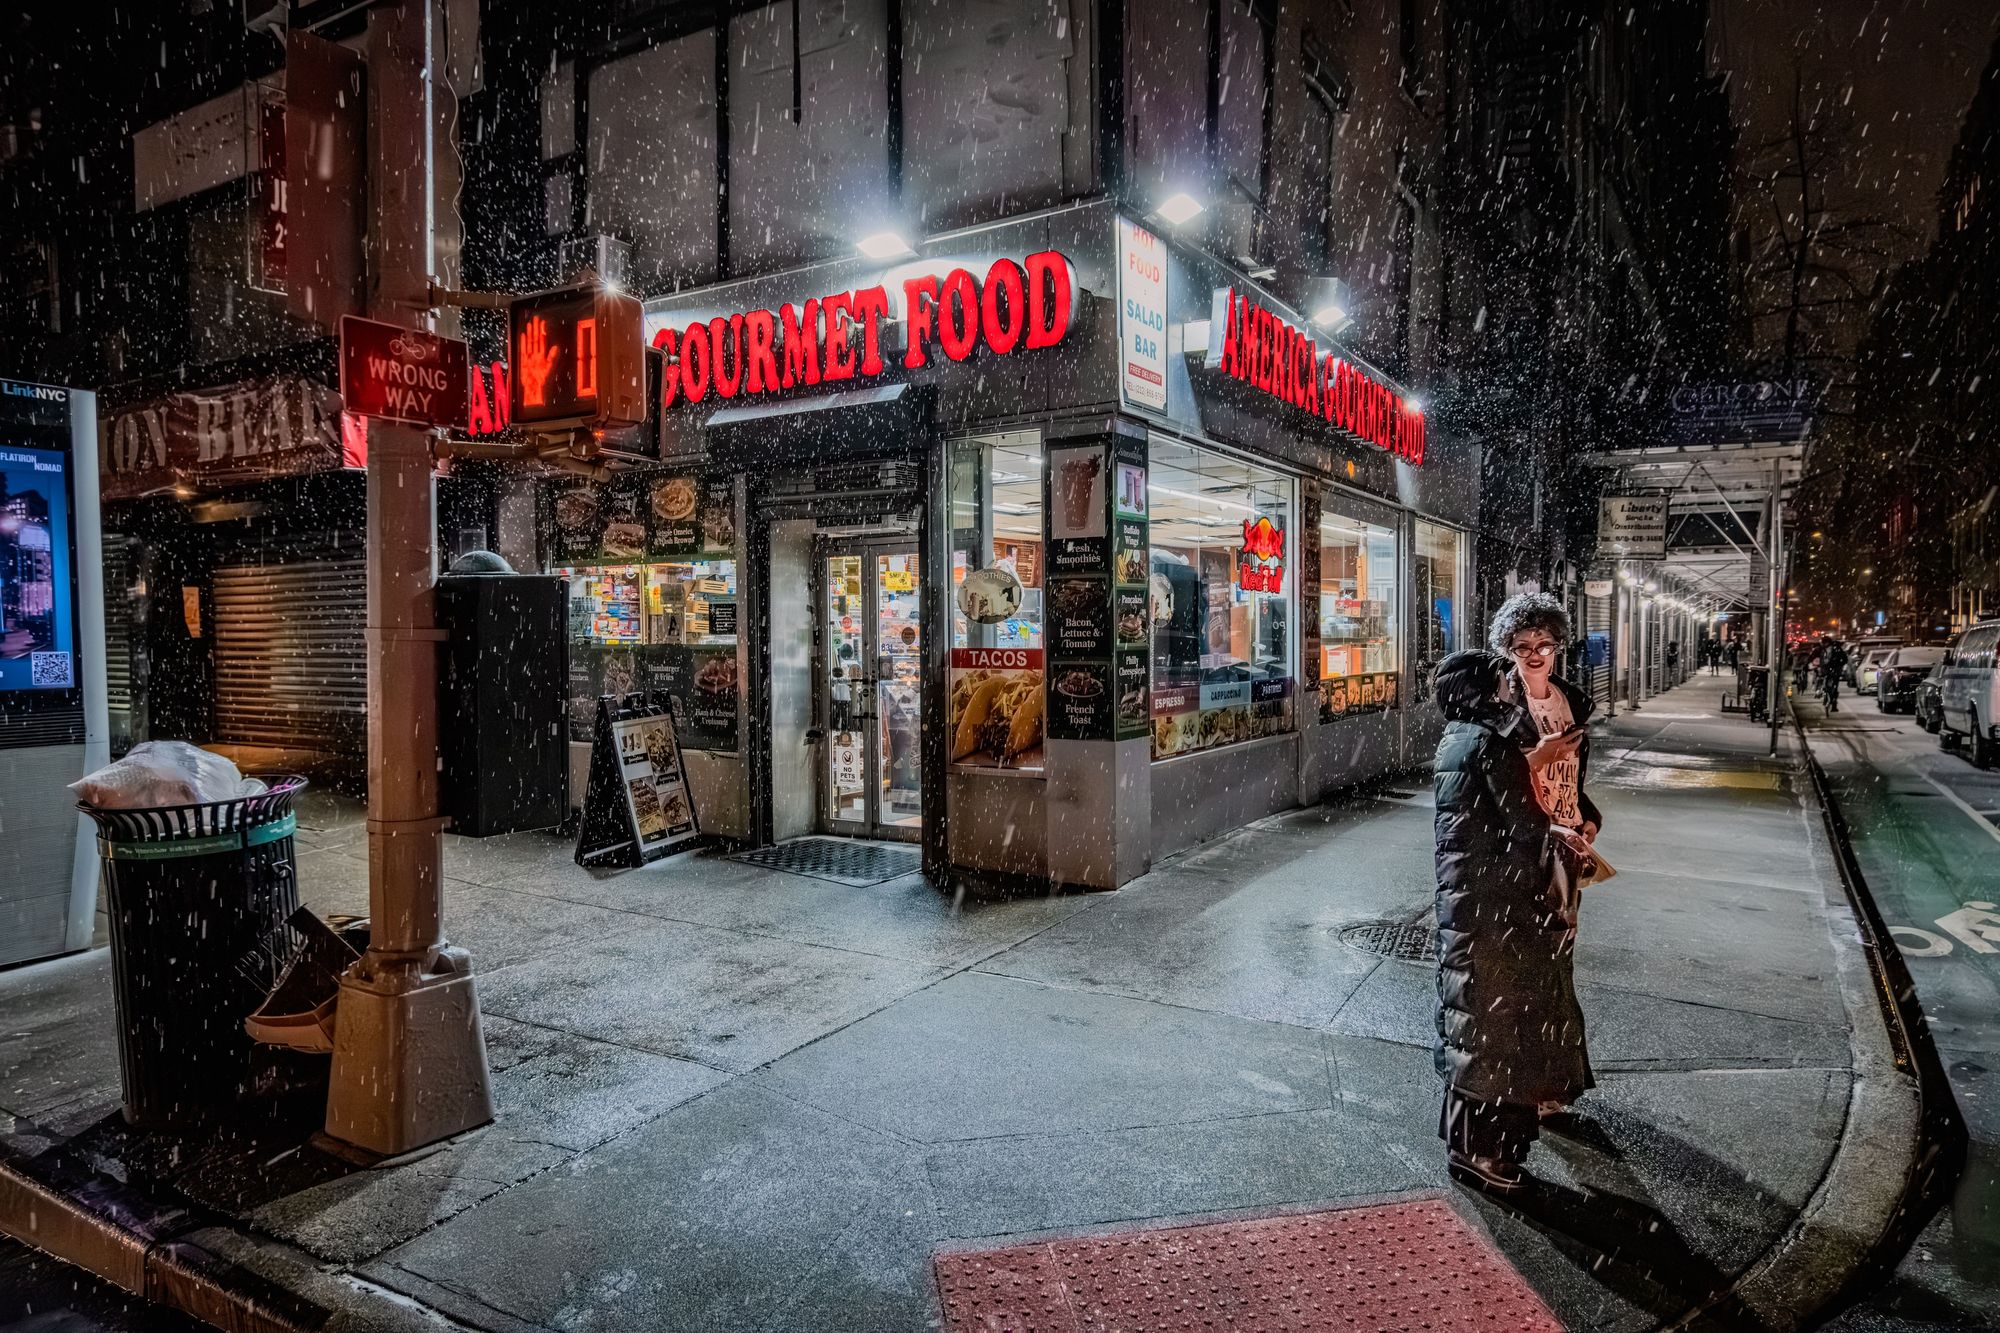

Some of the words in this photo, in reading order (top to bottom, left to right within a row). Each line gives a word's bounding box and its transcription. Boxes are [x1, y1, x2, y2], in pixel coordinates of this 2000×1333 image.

[1133, 225, 1155, 249] HOT
[1129, 252, 1160, 284] FOOD
[1127, 298, 1163, 332] SALAD
[652, 284, 889, 409] GOURMET
[903, 250, 1072, 370] FOOD
[1134, 334, 1157, 361] BAR
[367, 355, 448, 391] WRONG
[1129, 364, 1141, 377] FREE
[1221, 286, 1319, 417] AMERICA
[1323, 351, 1393, 450] GOURMET
[1394, 395, 1425, 466] FOOD
[2, 382, 67, 402] LinkNYC
[384, 385, 432, 417] WAY
[0, 452, 37, 464] FLATIRON
[34, 460, 62, 473] NOMAD
[1620, 502, 1664, 514] Liberty
[673, 527, 694, 536] Omelet
[1124, 535, 1140, 547] Wings
[1056, 554, 1101, 565] Smoothies
[1065, 618, 1095, 628] Bacon,
[1060, 627, 1092, 638] Lettuce
[1092, 628, 1100, 638] &
[1064, 639, 1097, 648] Tomato
[968, 650, 1028, 667] TACOS
[1210, 688, 1242, 702] CAPPUCCINO
[1065, 703, 1095, 714] French
[1154, 695, 1186, 710] ESPRESSO
[1068, 714, 1092, 725] Toast
[840, 772, 856, 780] PETS
